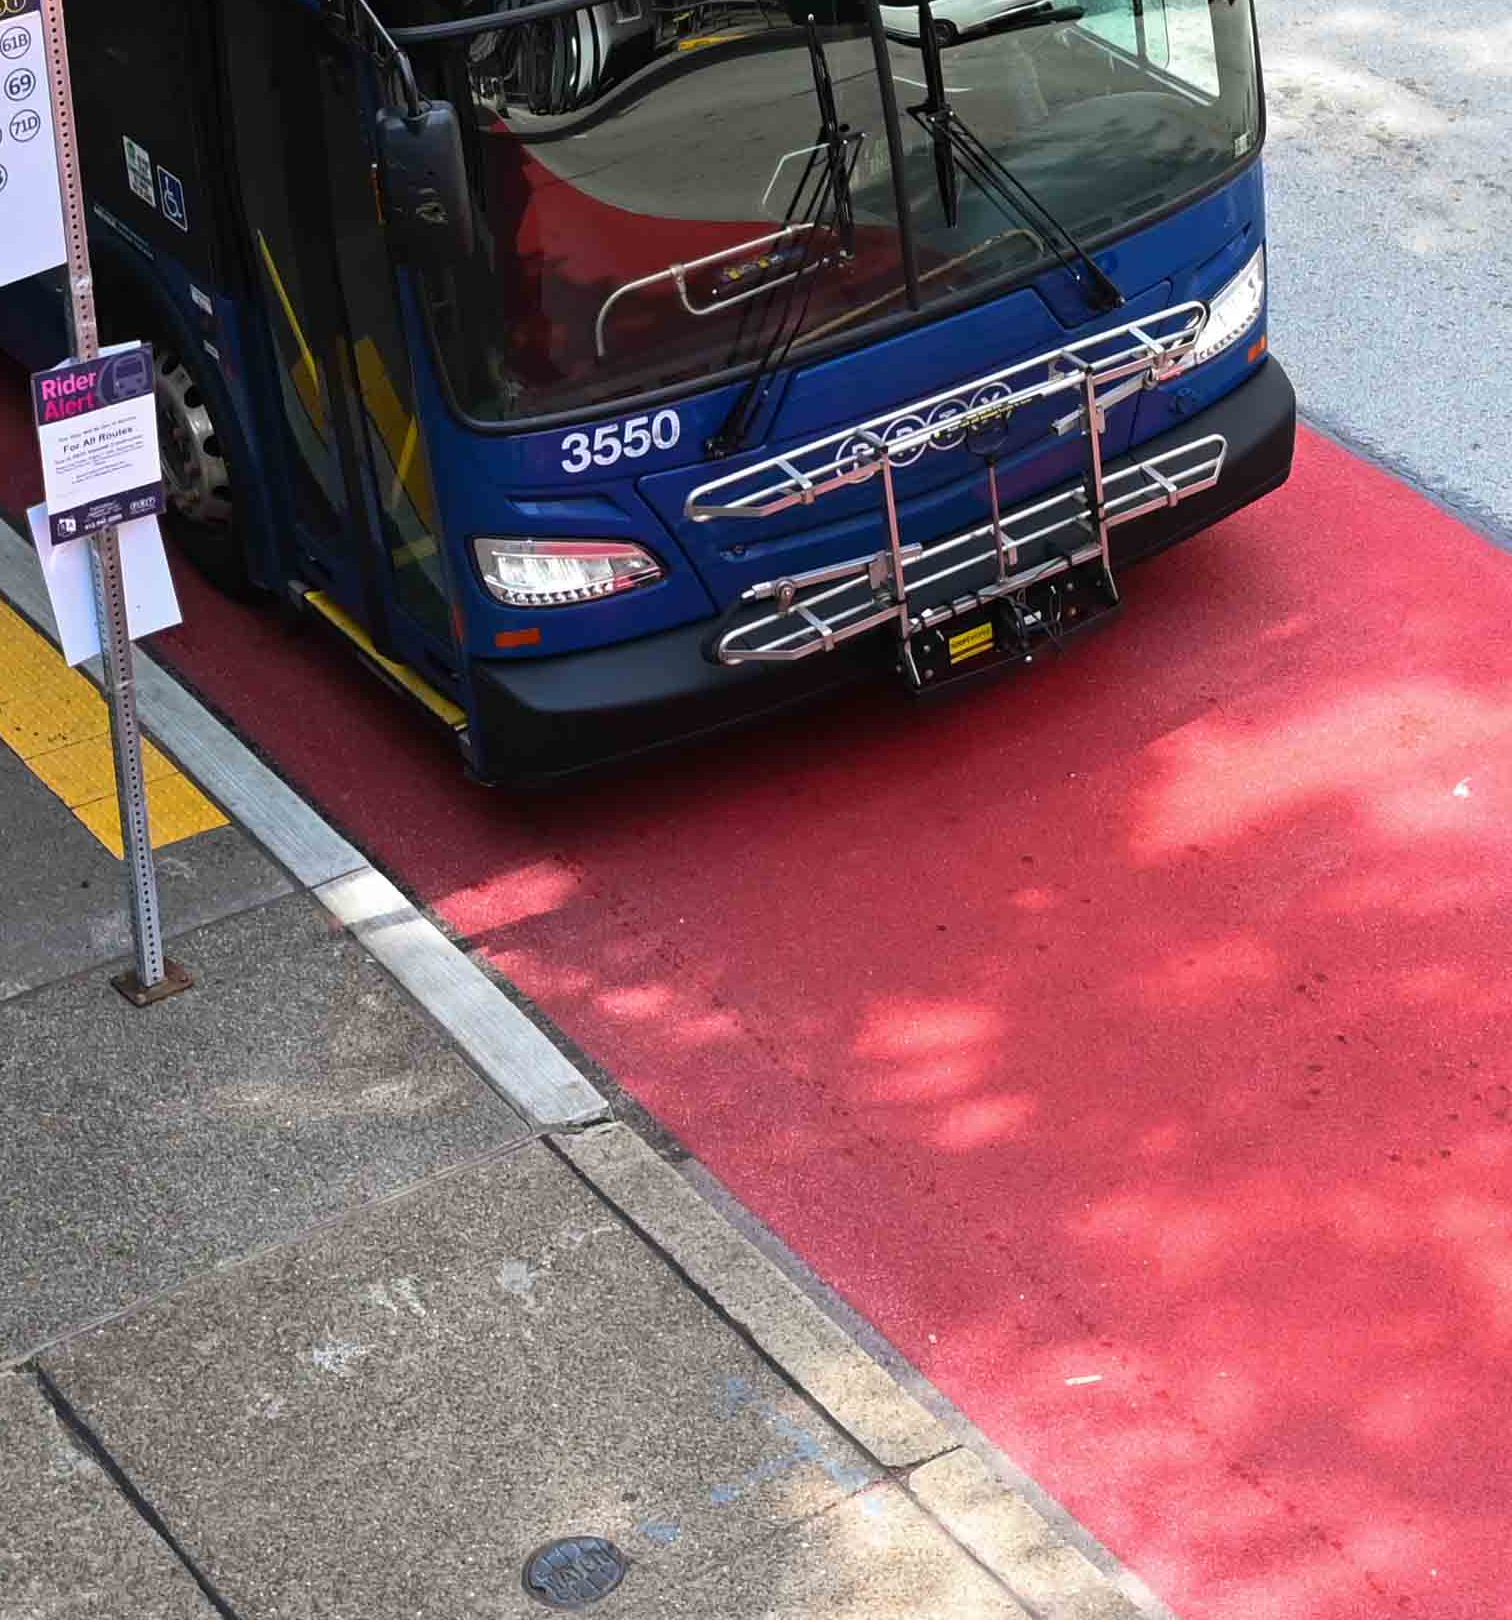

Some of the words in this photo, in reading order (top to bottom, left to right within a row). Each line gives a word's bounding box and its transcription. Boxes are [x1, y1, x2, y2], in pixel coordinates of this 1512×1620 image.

[2, 32, 29, 53] 61B
[8, 73, 32, 96] 69
[12, 115, 38, 136] 71D
[41, 372, 97, 401] Rider
[43, 391, 96, 421] Alert
[63, 442, 80, 454] For
[83, 434, 96, 447] All
[98, 426, 134, 443] Routes
[560, 409, 681, 473] 3550
